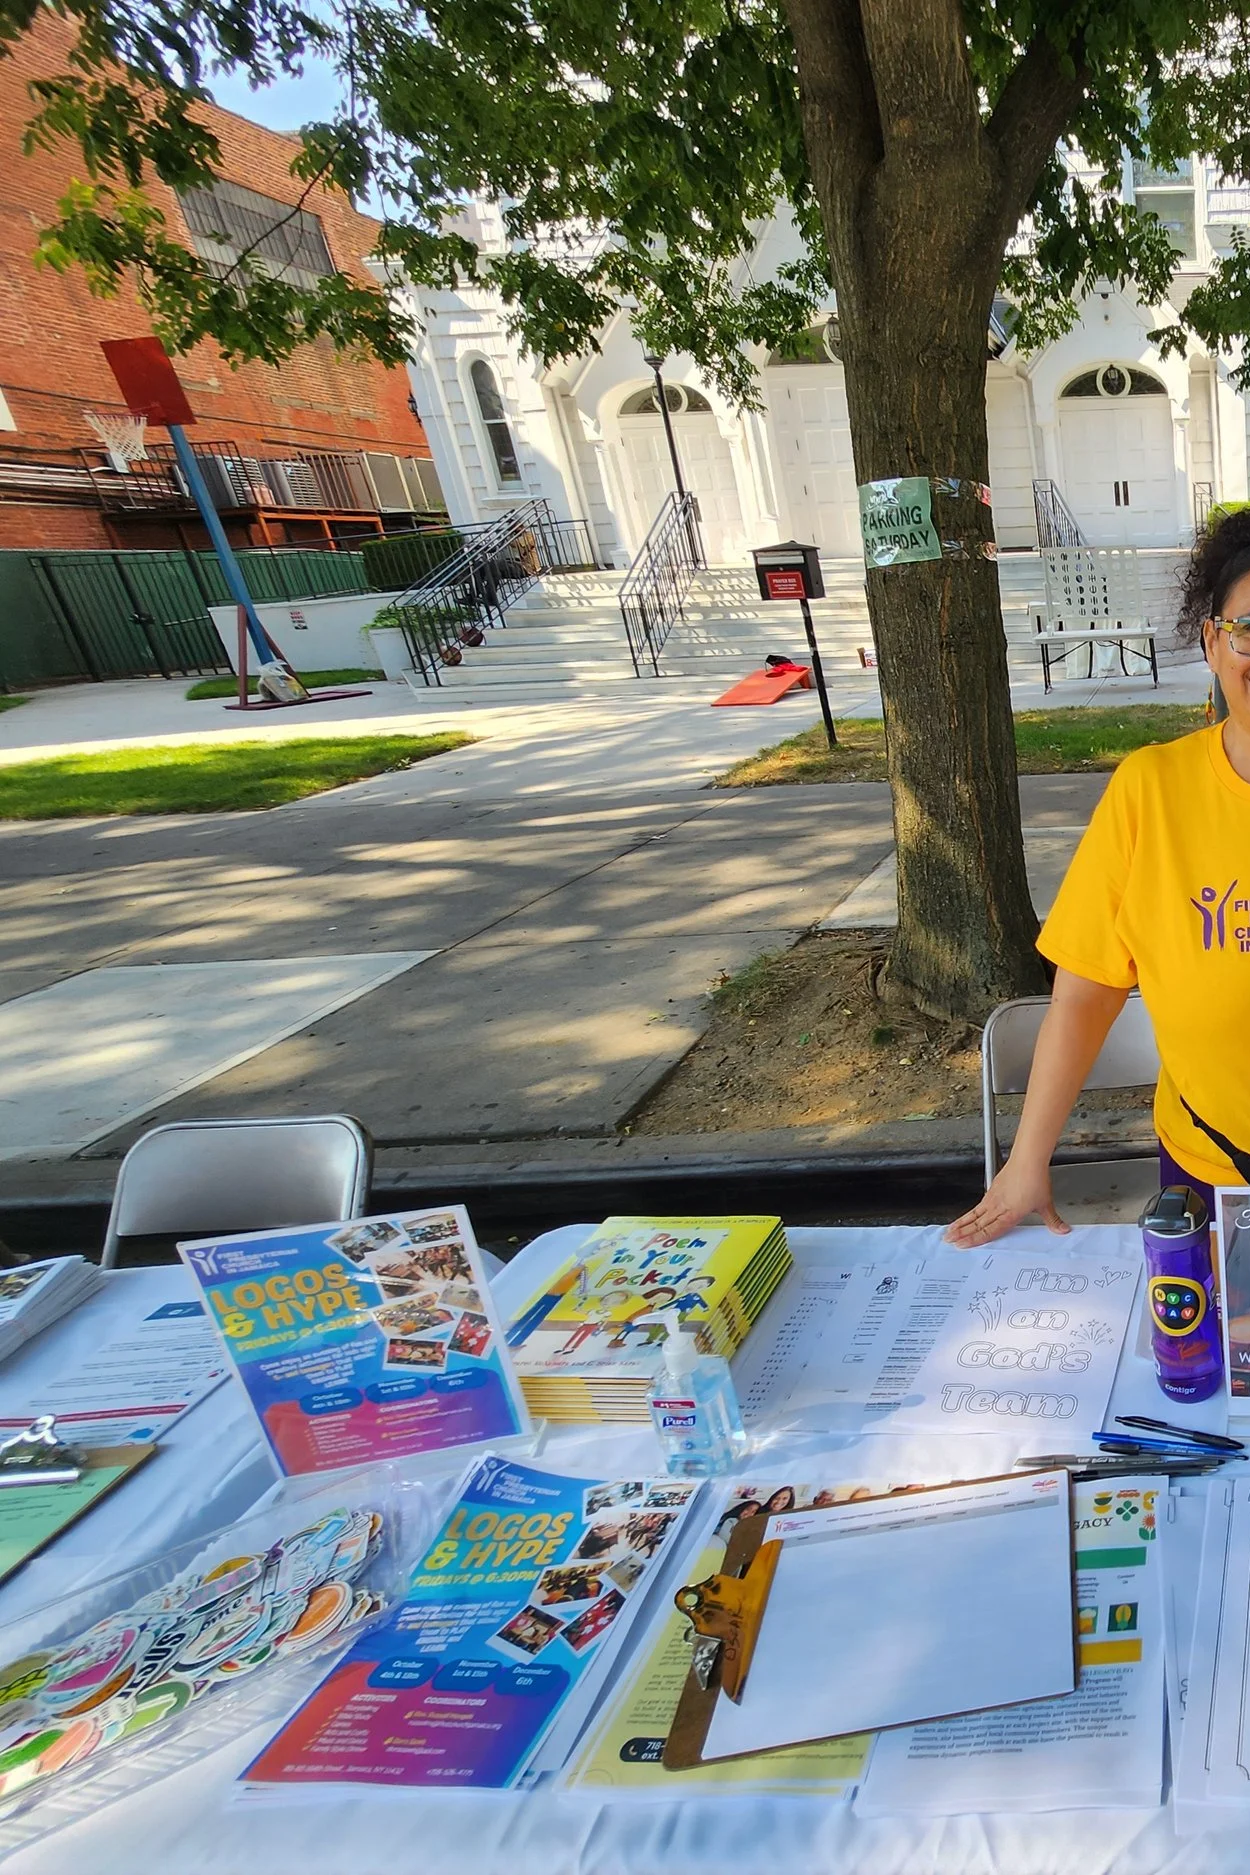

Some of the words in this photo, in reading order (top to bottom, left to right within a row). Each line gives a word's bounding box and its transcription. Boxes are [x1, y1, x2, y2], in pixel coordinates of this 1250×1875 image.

[862, 506, 922, 532] PARKING
[865, 530, 929, 556] SATURDAY
[641, 1232, 707, 1251] Poem
[218, 1251, 245, 1260] FIRST
[612, 1252, 636, 1265] in
[639, 1249, 696, 1269] Your
[210, 1263, 349, 1315] LOGOS
[594, 1267, 693, 1289] Pocket
[1014, 1267, 1089, 1294] I'm
[222, 1311, 256, 1338] &
[261, 1284, 367, 1330] HYPE
[1006, 1308, 1070, 1331] on
[957, 1341, 1093, 1373] God's
[1165, 1383, 1197, 1395] contigo
[941, 1383, 1079, 1418] Team
[666, 1415, 694, 1425] Purell
[444, 1508, 574, 1541] LOGOS
[424, 1540, 460, 1570] &
[460, 1538, 565, 1569] HYPE
[412, 1572, 471, 1588] FRIDAYS
[484, 1570, 543, 1584] 6:30PM
[512, 1666, 553, 1677] December
[516, 1677, 533, 1687] 6th
[641, 1751, 658, 1760] ext.
